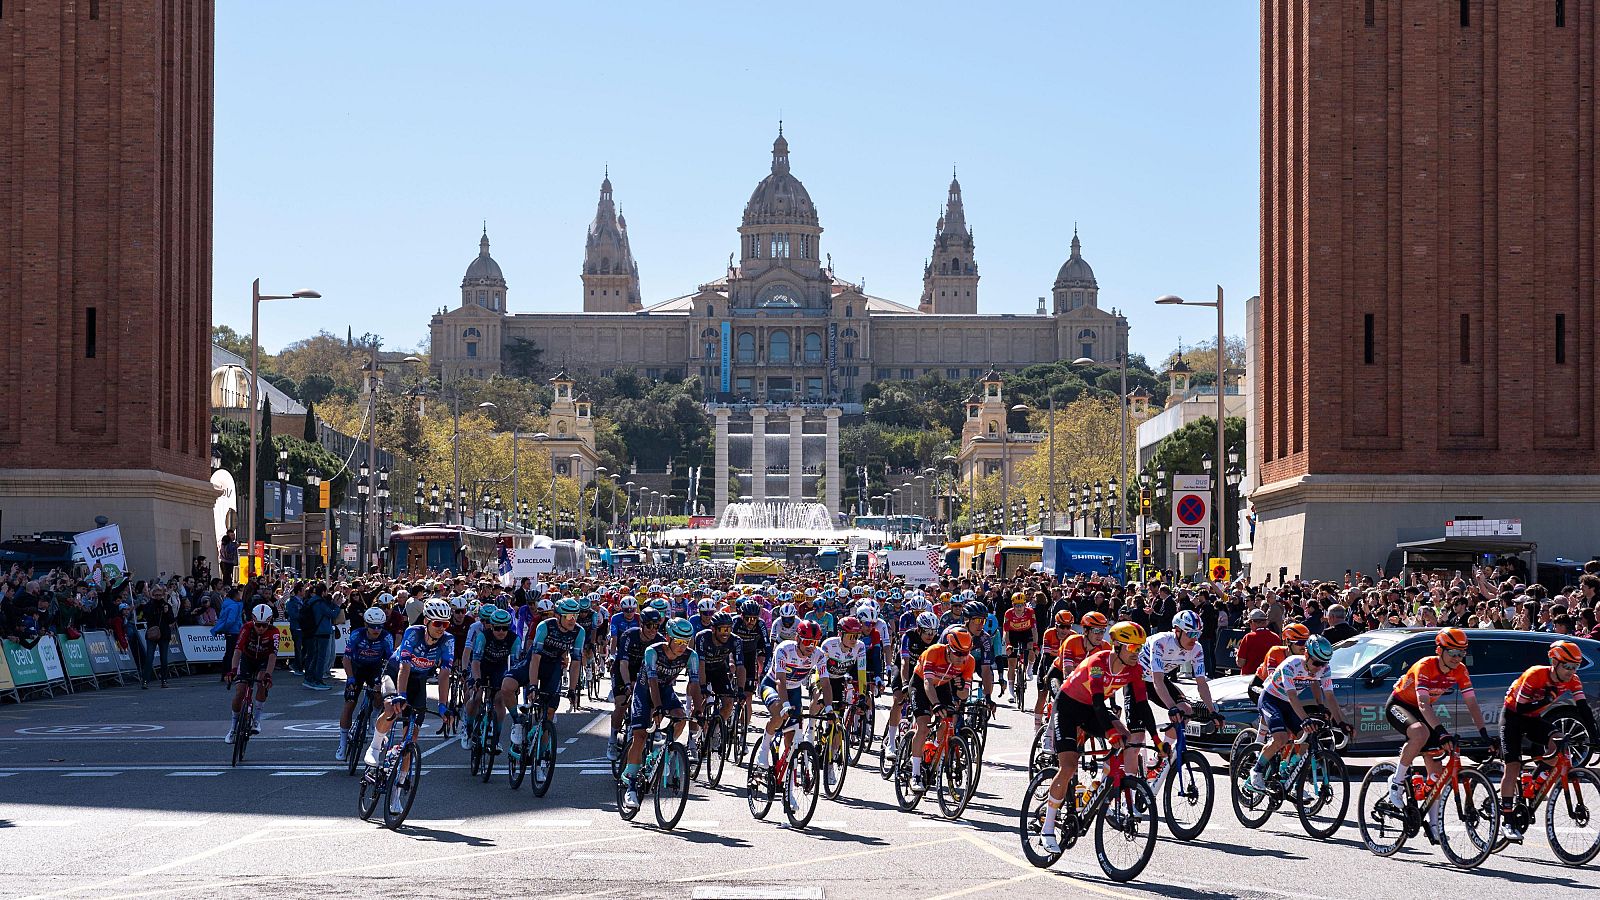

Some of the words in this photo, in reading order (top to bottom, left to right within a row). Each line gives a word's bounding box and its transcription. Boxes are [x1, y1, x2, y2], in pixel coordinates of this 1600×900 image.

[87, 542, 119, 559] Volta
[1361, 723, 1391, 731] Official
[1371, 766, 1380, 776] NO
[1081, 777, 1107, 820] RIDLEY
